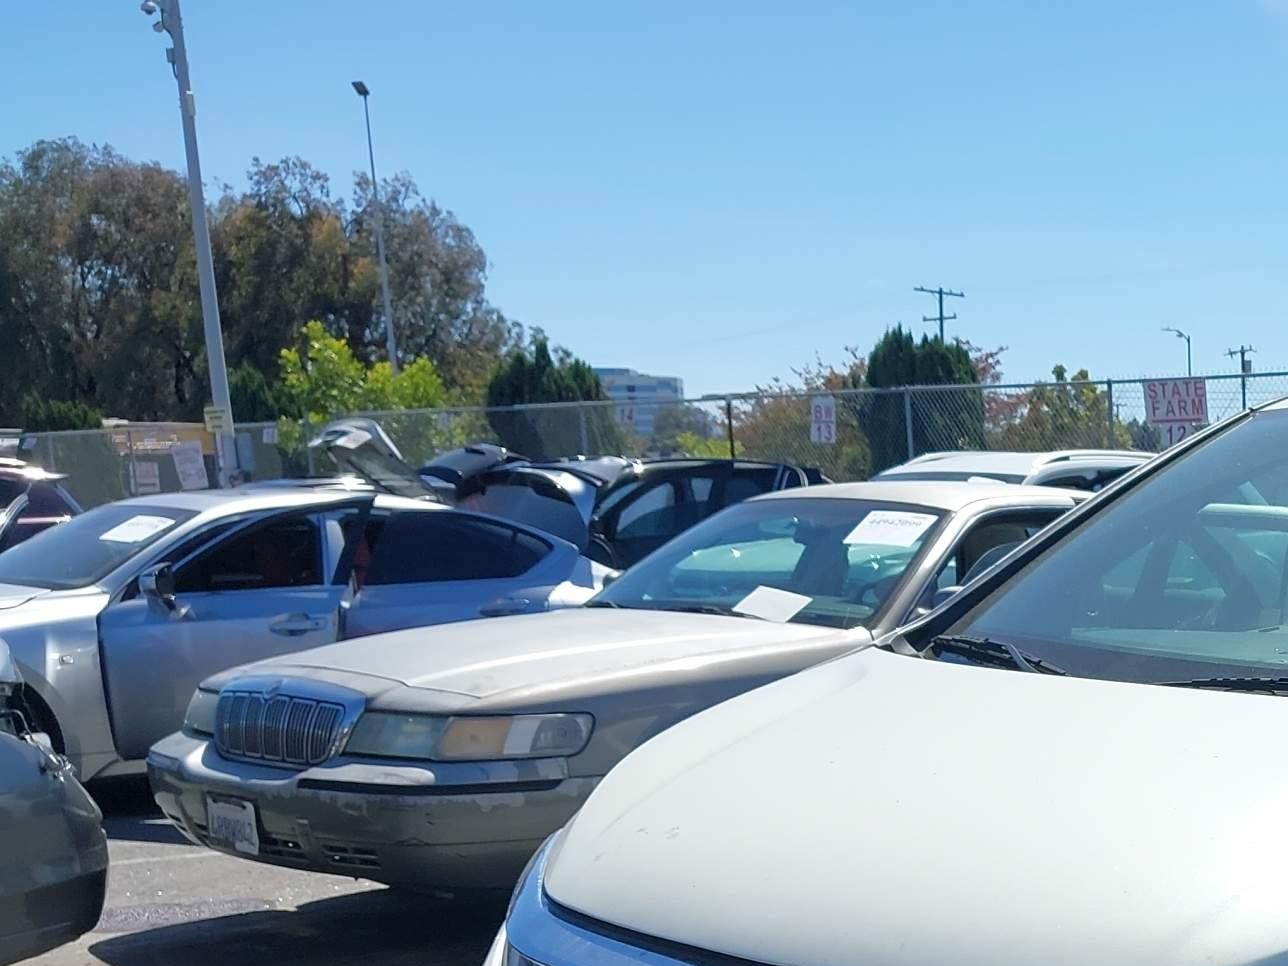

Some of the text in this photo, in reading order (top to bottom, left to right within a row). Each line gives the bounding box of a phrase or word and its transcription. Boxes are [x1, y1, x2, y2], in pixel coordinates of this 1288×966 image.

[1147, 381, 1204, 399] STATE
[1152, 399, 1204, 417] FARM
[817, 424, 833, 441] 13
[1166, 425, 1187, 445] 12
